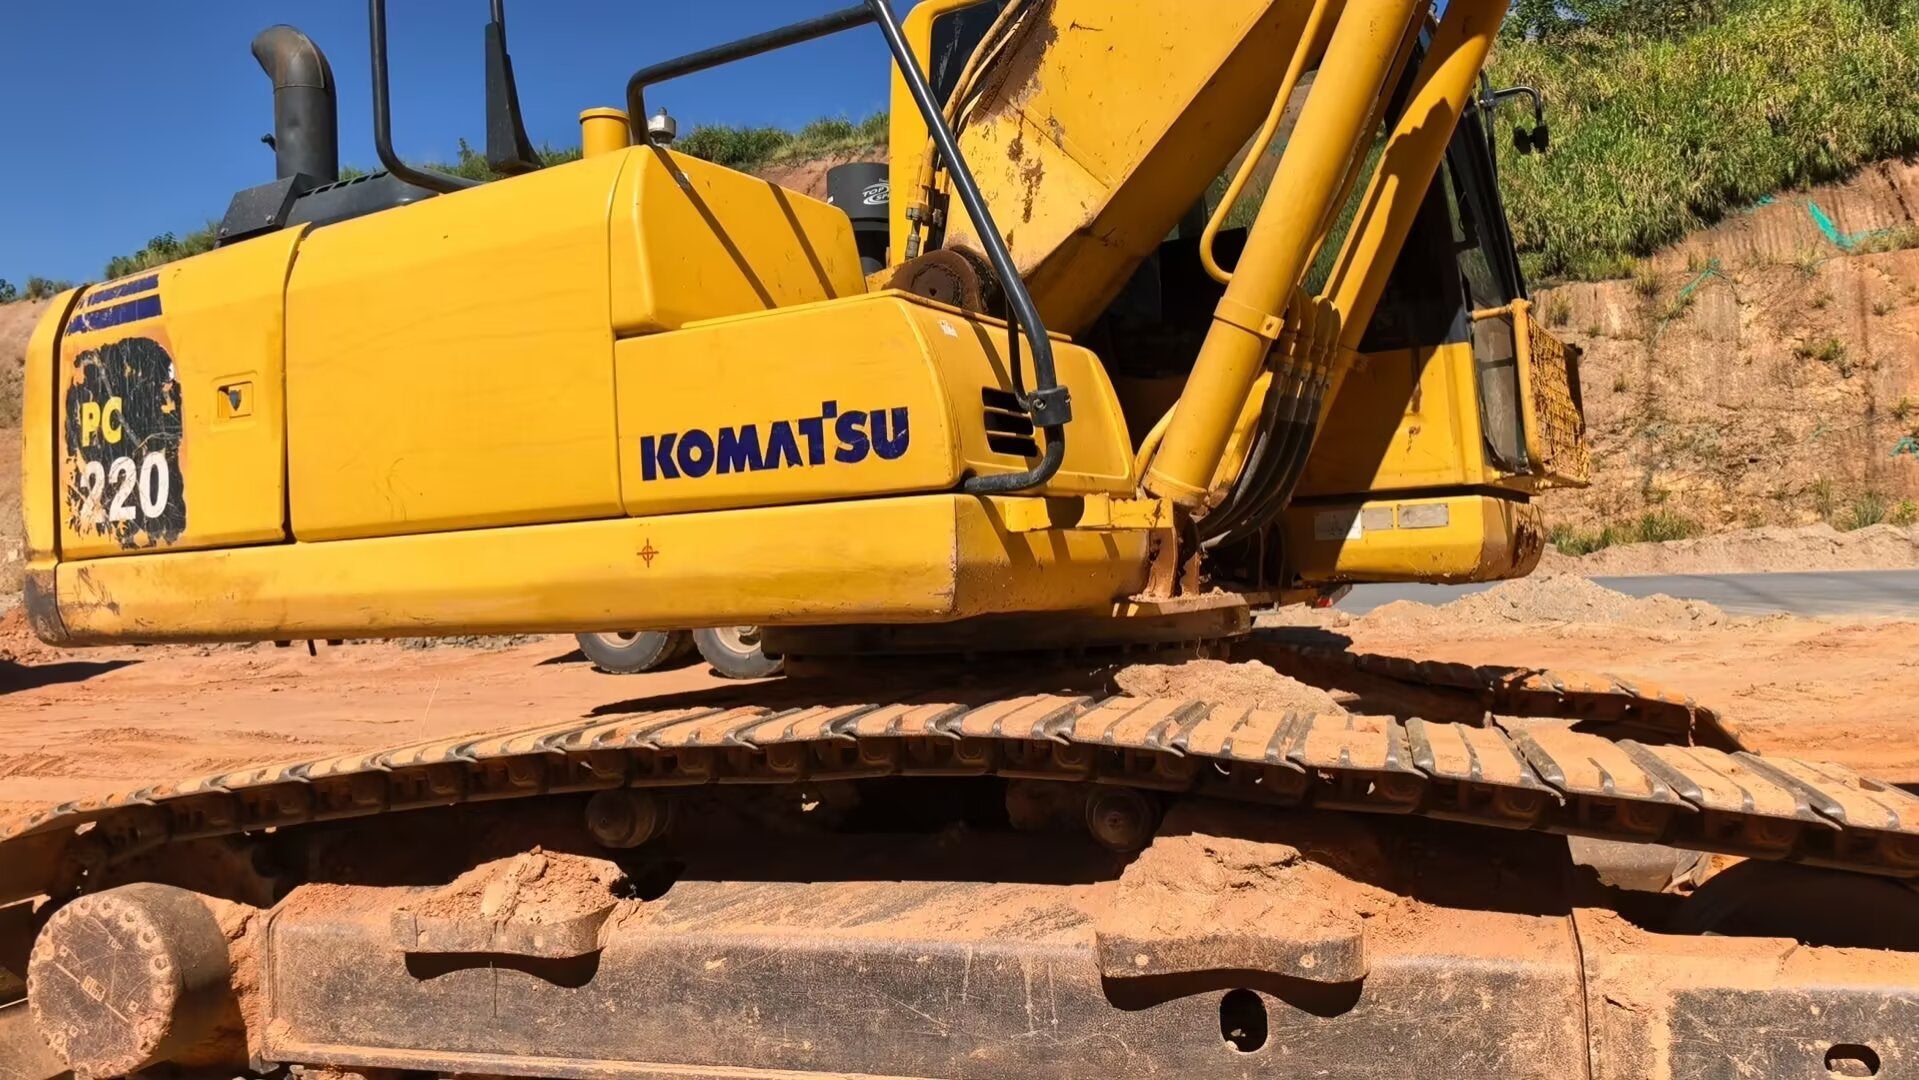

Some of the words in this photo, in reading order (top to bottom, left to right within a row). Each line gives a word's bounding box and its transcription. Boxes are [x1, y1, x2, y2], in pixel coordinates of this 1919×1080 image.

[80, 397, 123, 447] PC
[640, 400, 910, 481] KOMATSU
[80, 452, 170, 522] 220
